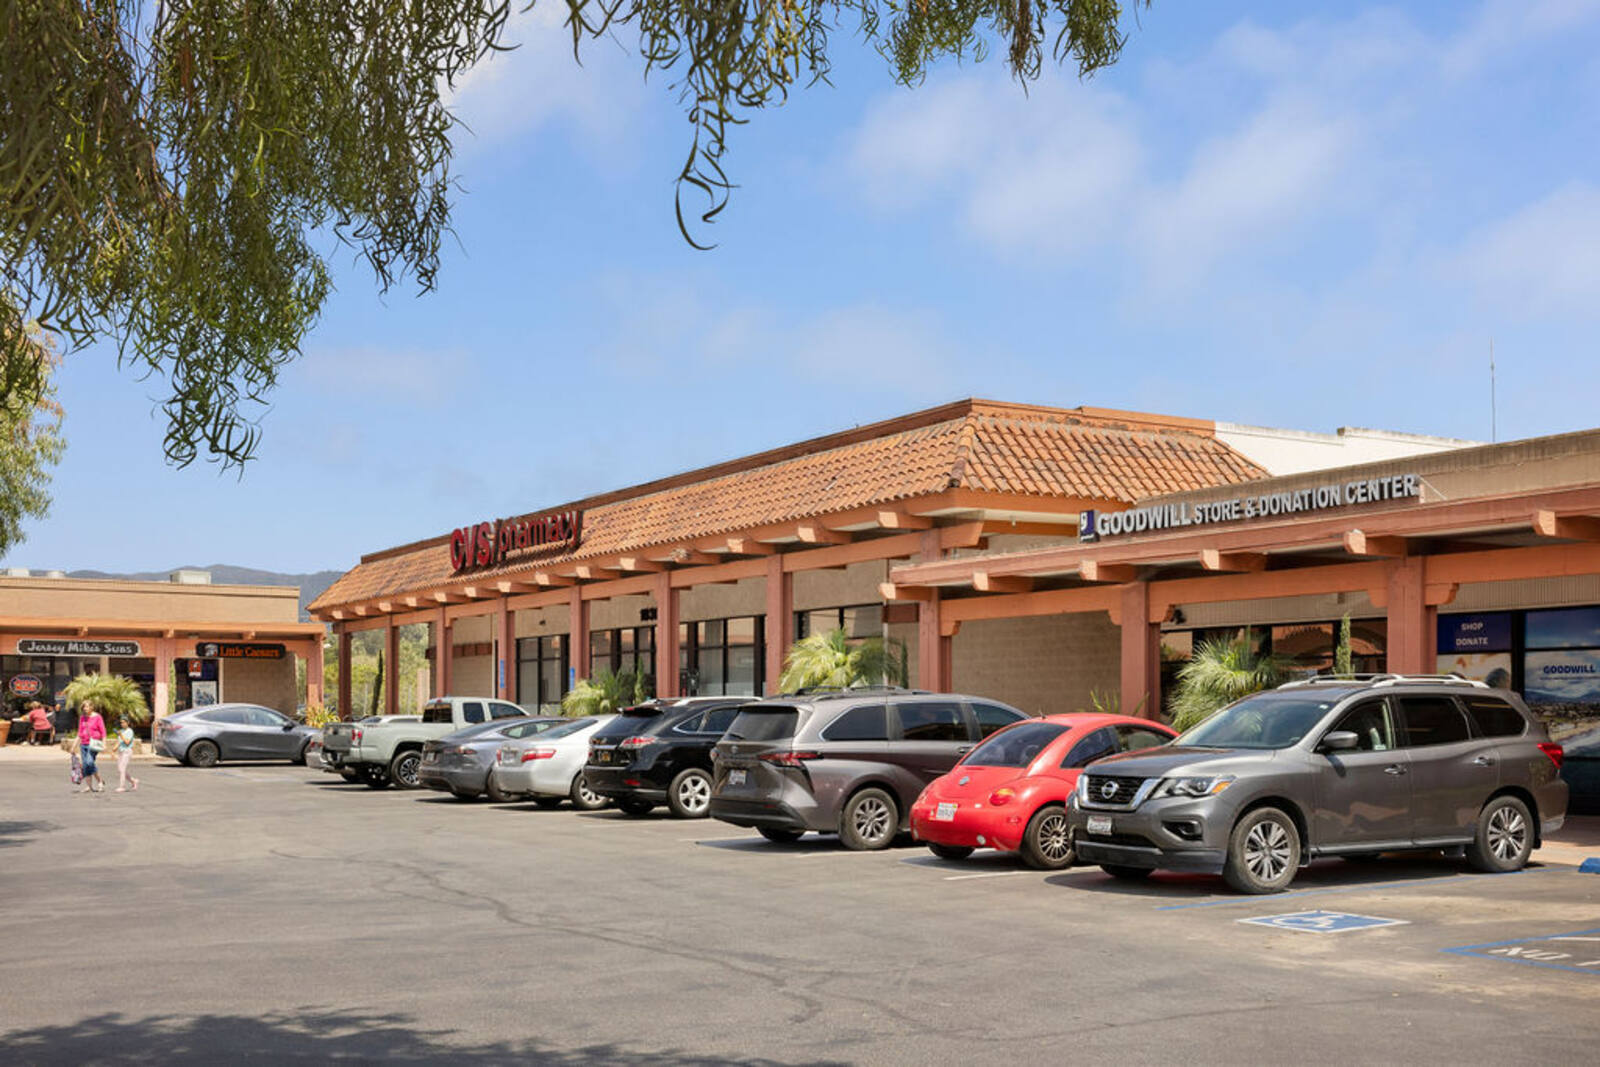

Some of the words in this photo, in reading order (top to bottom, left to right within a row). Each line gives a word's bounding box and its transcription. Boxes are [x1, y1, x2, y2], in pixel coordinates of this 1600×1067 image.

[1097, 502, 1191, 536] GOODWILL
[1194, 500, 1241, 524] STORE
[1245, 495, 1256, 518] &
[1259, 484, 1341, 517] DONATION
[1345, 474, 1417, 504] CENTER
[1461, 622, 1483, 631] SHOP
[1455, 637, 1488, 646] DONATE
[1543, 665, 1596, 674] GOODWILL
